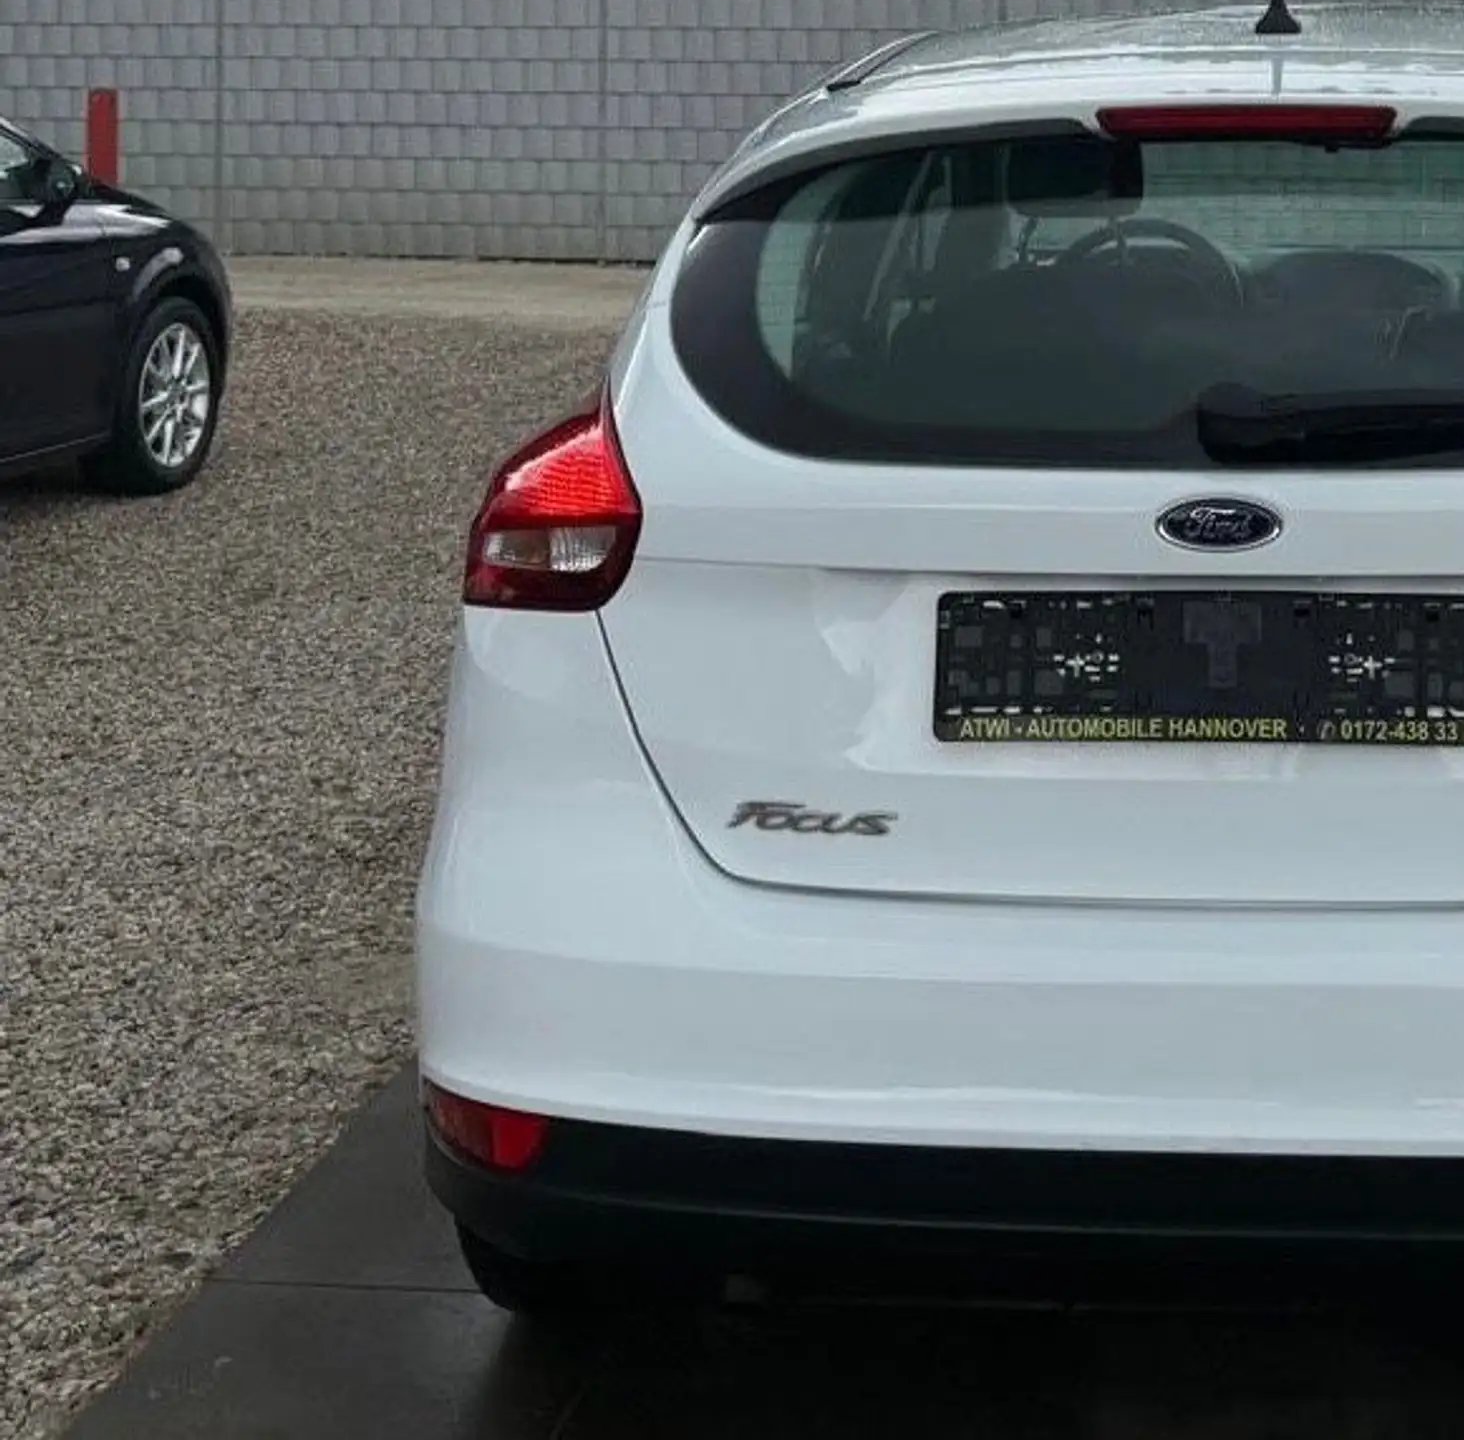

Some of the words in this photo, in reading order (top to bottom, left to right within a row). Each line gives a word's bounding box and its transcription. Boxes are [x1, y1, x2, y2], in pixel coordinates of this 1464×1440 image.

[1186, 506, 1253, 539] Ford
[959, 719, 1011, 738] ATWI
[1028, 719, 1164, 738] AUTOMOBILE
[1169, 719, 1286, 738] HANNOVER
[1340, 721, 1428, 741] 0172-438
[1432, 721, 1459, 742] 33
